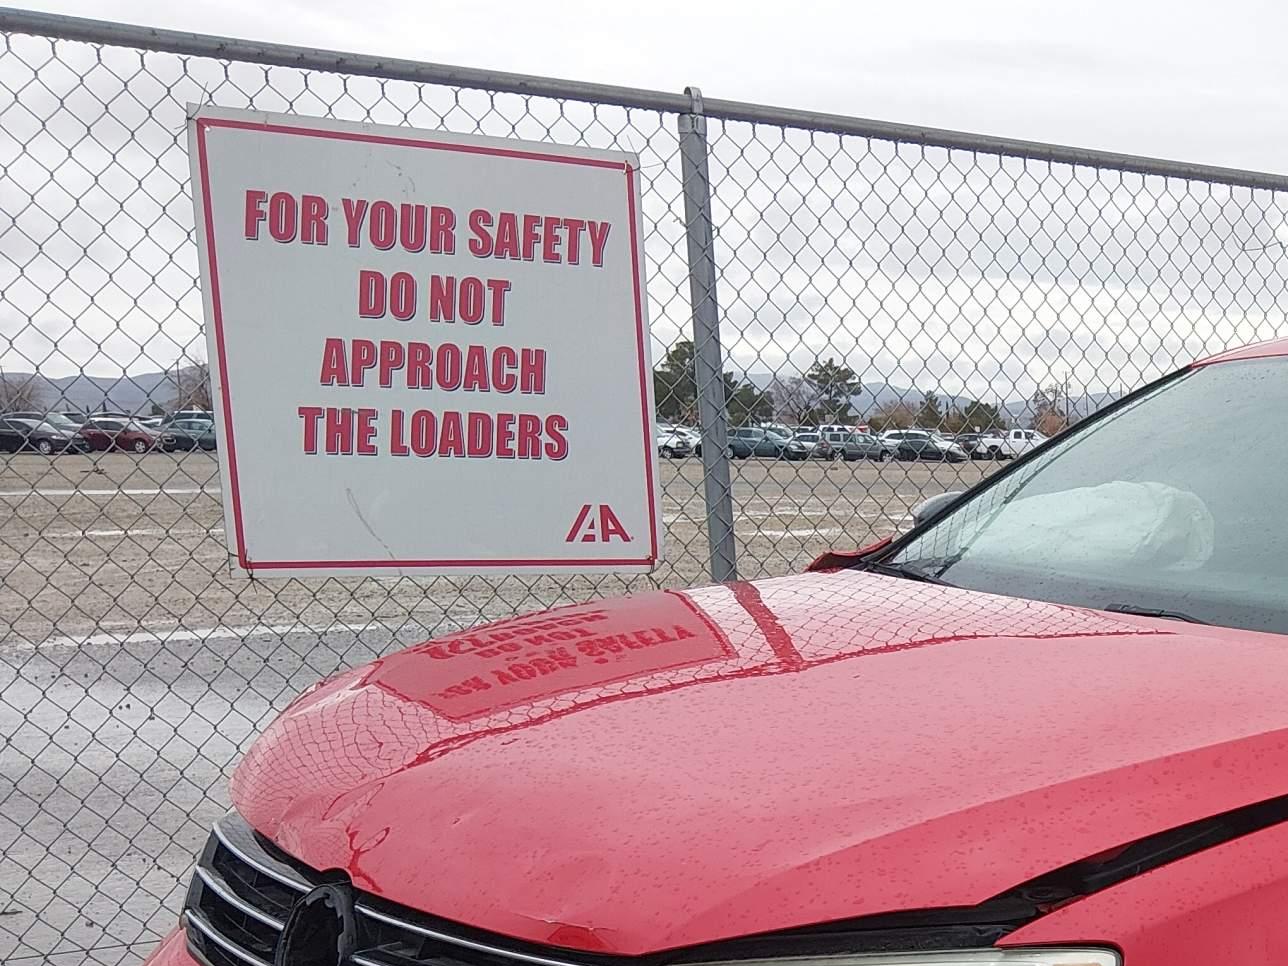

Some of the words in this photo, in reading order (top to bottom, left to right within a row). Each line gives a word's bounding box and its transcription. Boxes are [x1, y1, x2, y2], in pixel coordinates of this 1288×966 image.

[244, 190, 329, 245] FOR
[341, 198, 457, 256] YOUR
[468, 208, 612, 267] SAFETY
[358, 270, 417, 322] DO
[429, 274, 512, 327] NOT
[319, 337, 547, 395] APPROACH
[297, 406, 379, 456] THE
[389, 408, 569, 461] LOADERS
